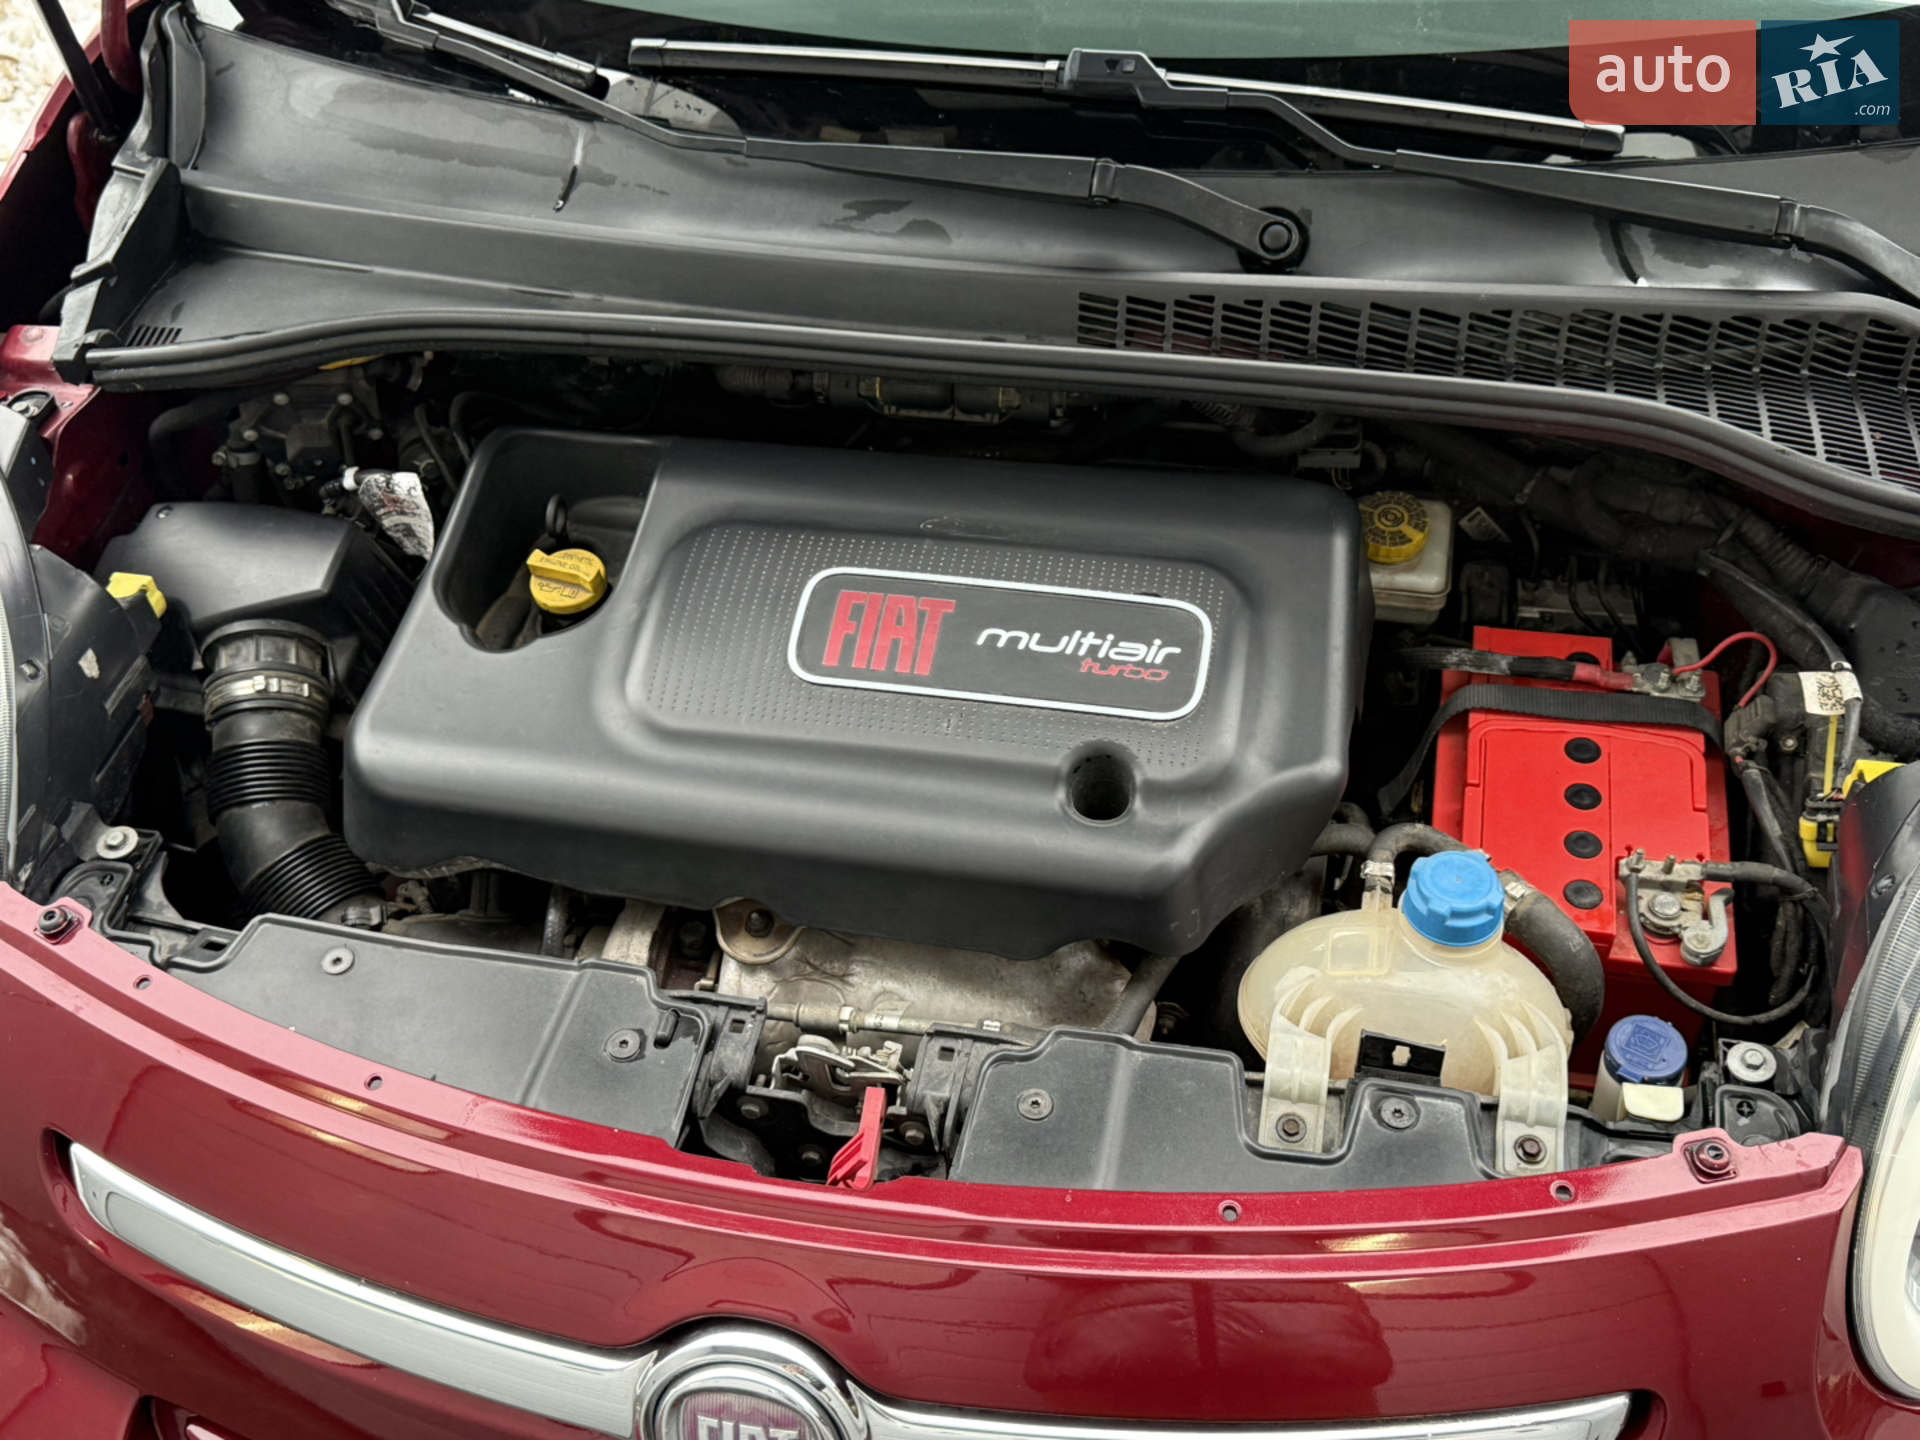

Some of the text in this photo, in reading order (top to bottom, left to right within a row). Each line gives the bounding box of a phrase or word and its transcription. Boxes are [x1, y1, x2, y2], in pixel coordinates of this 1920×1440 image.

[540, 557, 581, 571] ENGINE OIL
[822, 589, 956, 676] FIAT
[976, 627, 1182, 665] multiair
[1080, 658, 1169, 681] turbo
